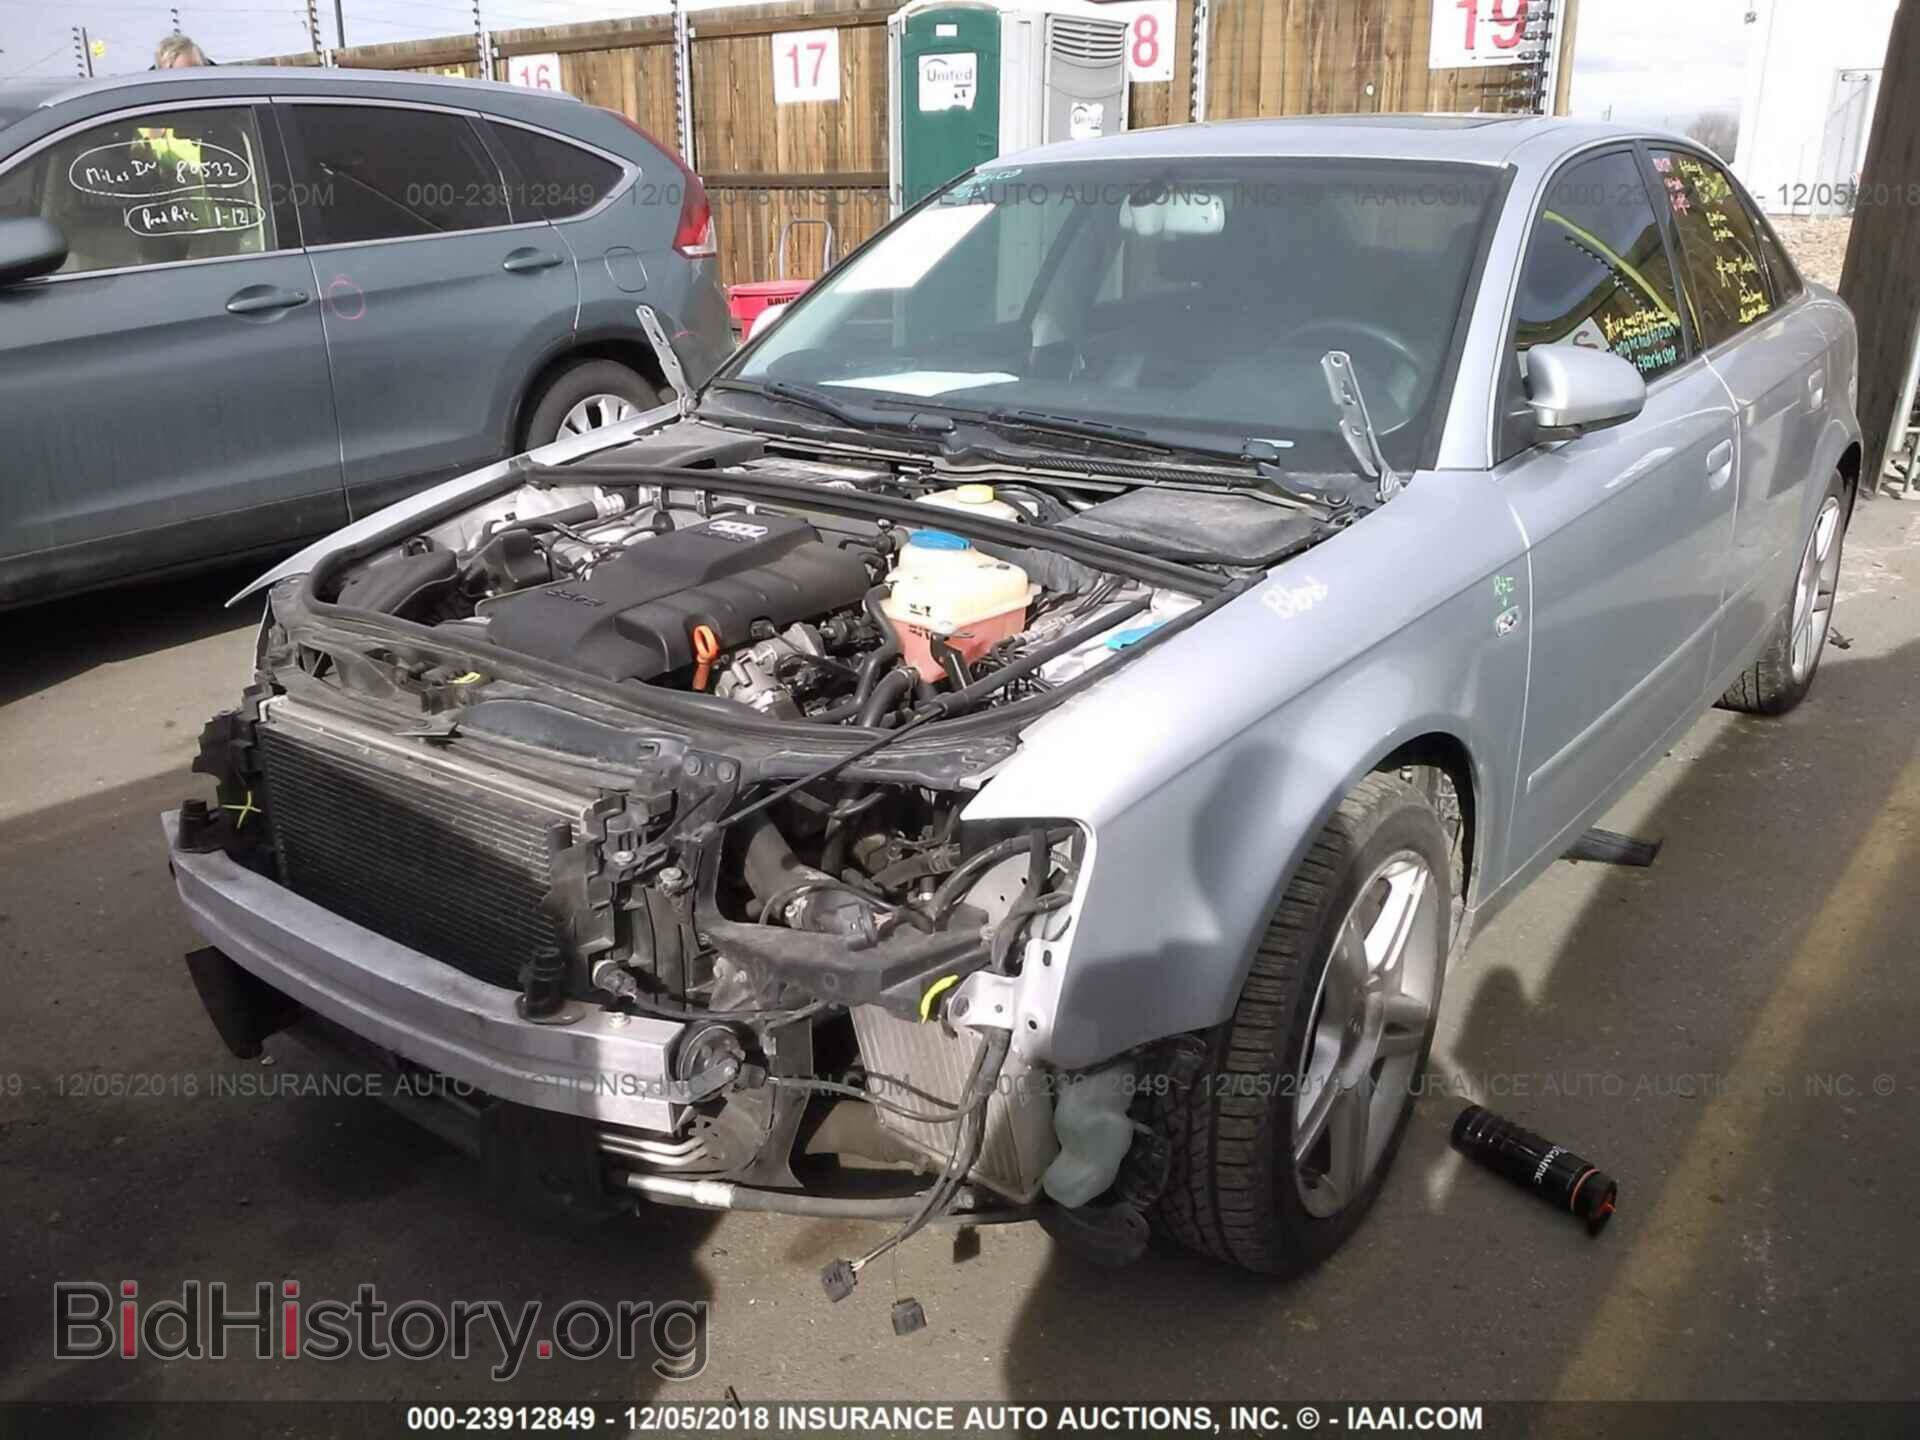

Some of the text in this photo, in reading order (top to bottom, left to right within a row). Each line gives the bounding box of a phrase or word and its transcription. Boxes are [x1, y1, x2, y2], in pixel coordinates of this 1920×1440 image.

[1456, 0, 1528, 49] 19
[520, 63, 552, 88] 16
[786, 42, 828, 88] 17
[926, 66, 973, 82] United
